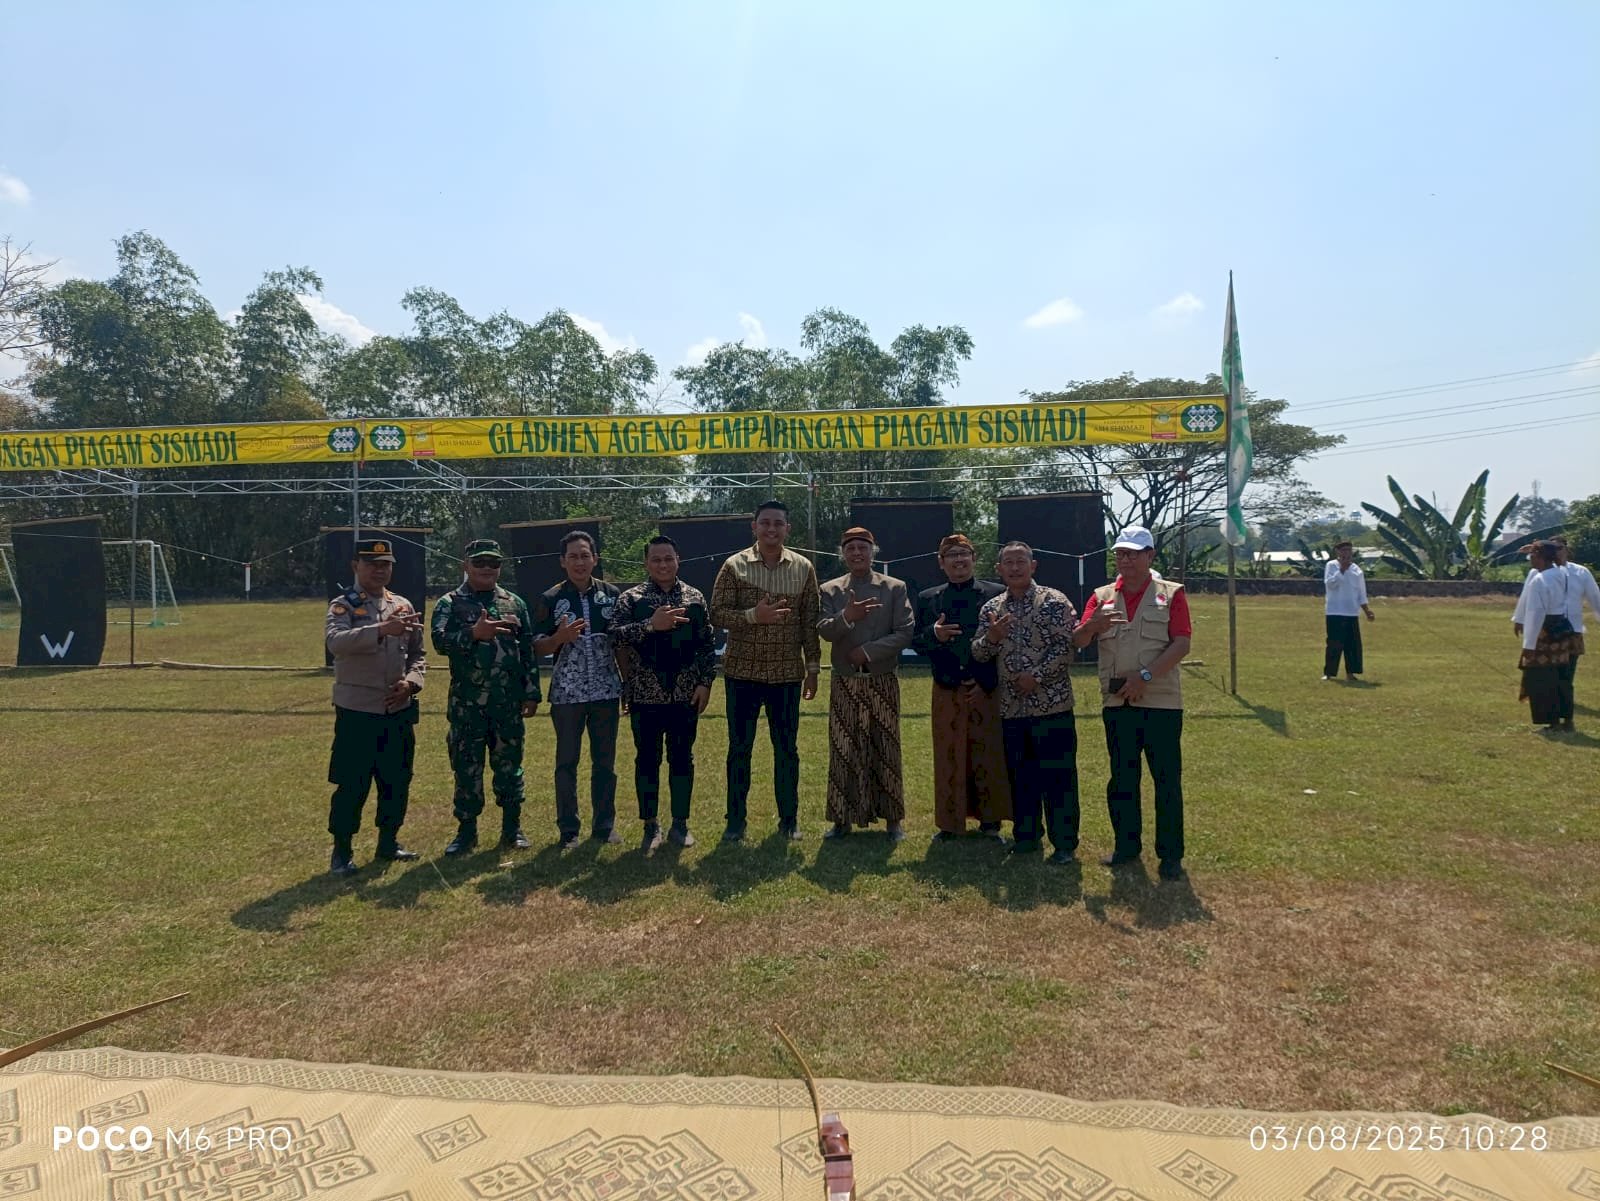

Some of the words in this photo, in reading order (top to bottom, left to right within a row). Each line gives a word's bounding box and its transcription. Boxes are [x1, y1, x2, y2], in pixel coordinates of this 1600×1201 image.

[0, 437, 60, 467] NGAN
[64, 433, 143, 466] PIAGAM
[150, 430, 238, 464] SISMADI
[488, 420, 599, 454] GLADHEN
[608, 419, 687, 453] AGENG
[695, 414, 864, 450] JEMPARINGAN
[873, 411, 968, 448] PIAGAM
[978, 407, 1086, 444] SISMADI
[40, 630, 75, 659] W
